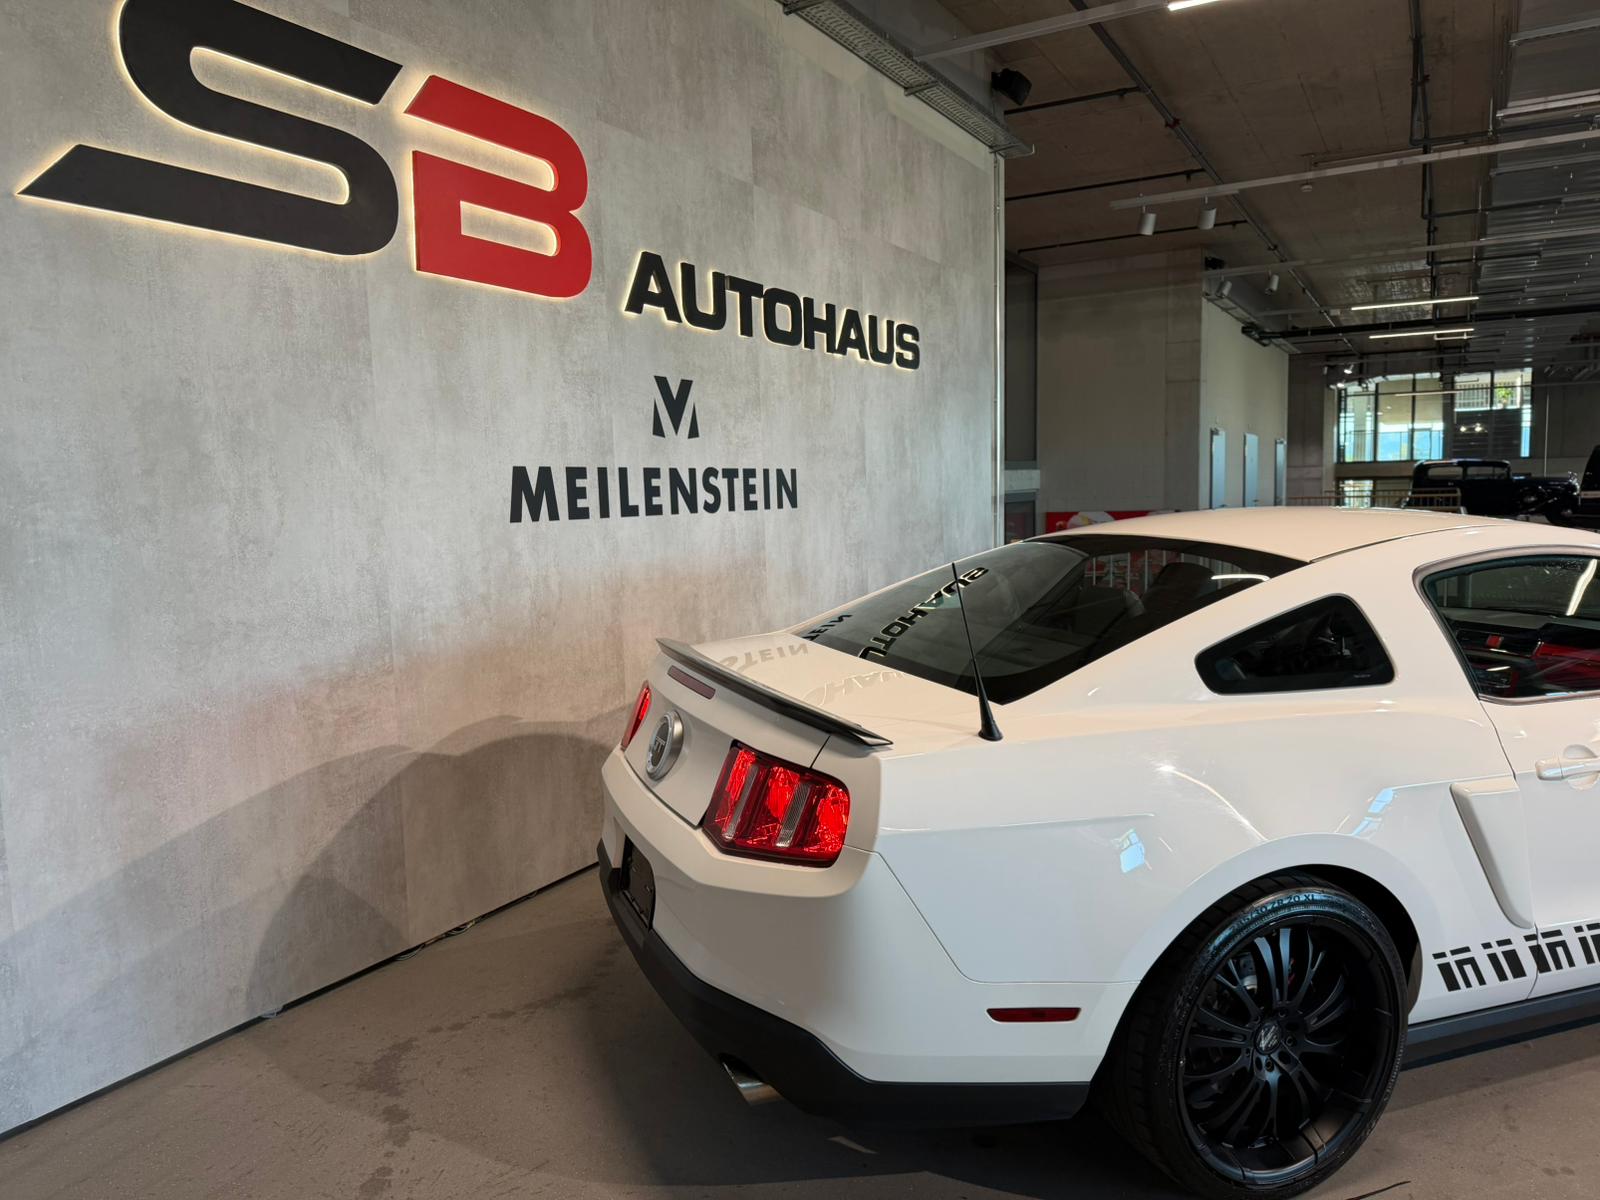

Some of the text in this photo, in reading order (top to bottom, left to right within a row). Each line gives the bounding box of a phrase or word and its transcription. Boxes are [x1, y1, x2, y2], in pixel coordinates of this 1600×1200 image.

[18, 0, 920, 370] SB AUTOHAUS
[510, 465, 798, 523] MEILENSTEIN
[1287, 894, 1300, 904] 20
